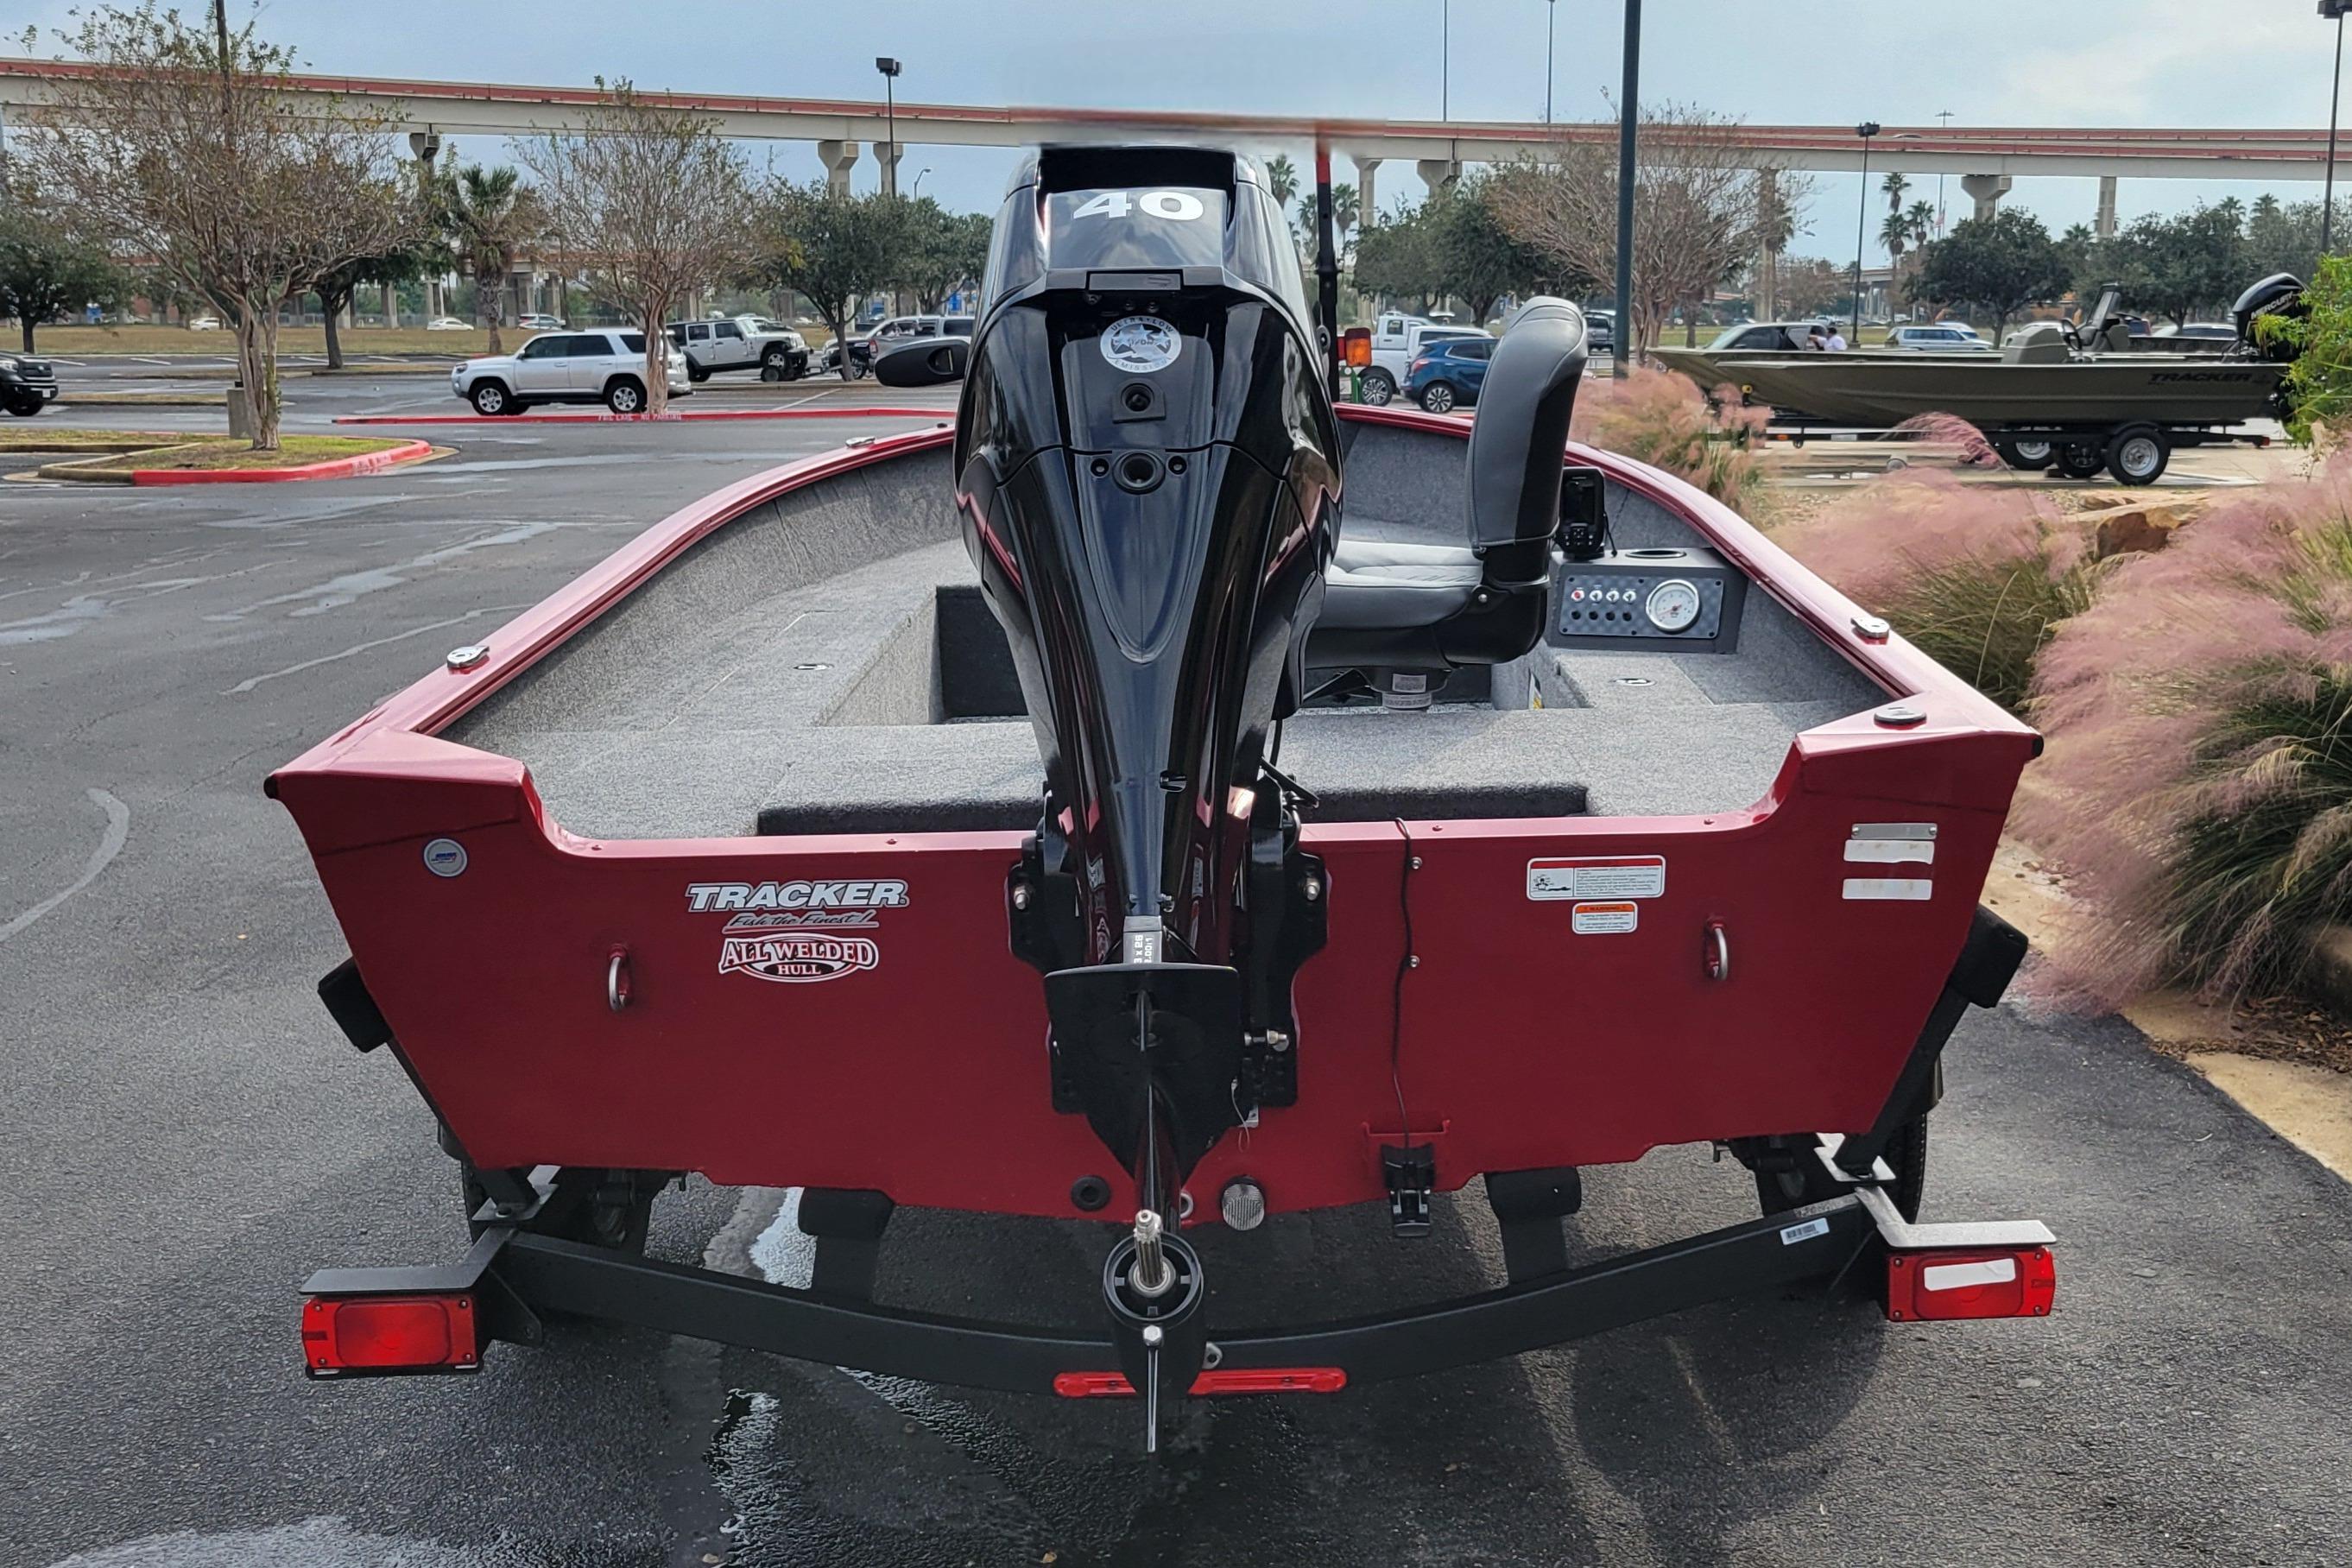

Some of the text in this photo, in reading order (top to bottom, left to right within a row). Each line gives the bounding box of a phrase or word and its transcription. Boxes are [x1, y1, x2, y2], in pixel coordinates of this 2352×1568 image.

[1073, 192, 1204, 220] 40
[2150, 372, 2253, 382] TRACKER
[688, 882, 906, 910] TRACKER
[730, 915, 766, 926] Fish
[768, 914, 796, 926] the
[724, 940, 874, 968] ALL WELDED
[778, 964, 821, 975] HULL
